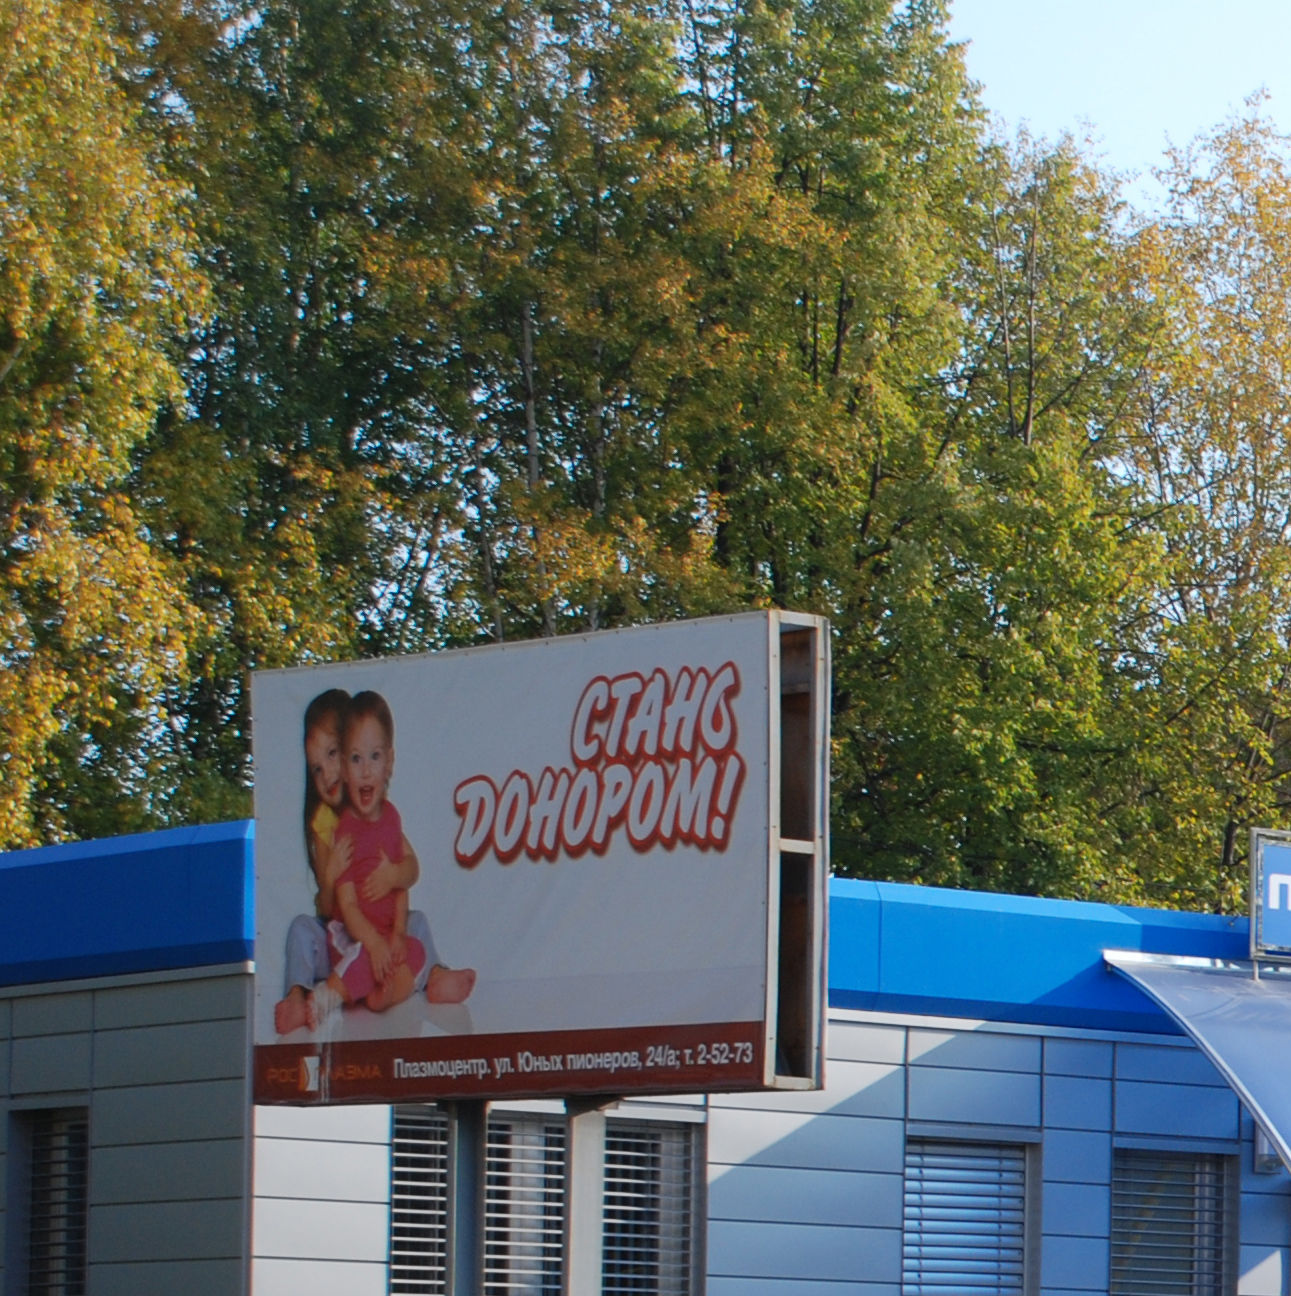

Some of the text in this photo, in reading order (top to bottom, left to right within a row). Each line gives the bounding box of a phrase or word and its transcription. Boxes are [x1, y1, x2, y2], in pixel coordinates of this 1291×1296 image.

[569, 661, 741, 768] СТАНЬ
[454, 752, 747, 870] ДОНОРОМ!
[394, 1058, 492, 1080] Плазмоцентр.
[494, 1057, 514, 1079] ул.
[518, 1051, 564, 1073] Юных
[566, 1050, 642, 1074] пионеров,
[684, 1048, 695, 1066] т.
[697, 1042, 754, 1065] 2-52-73
